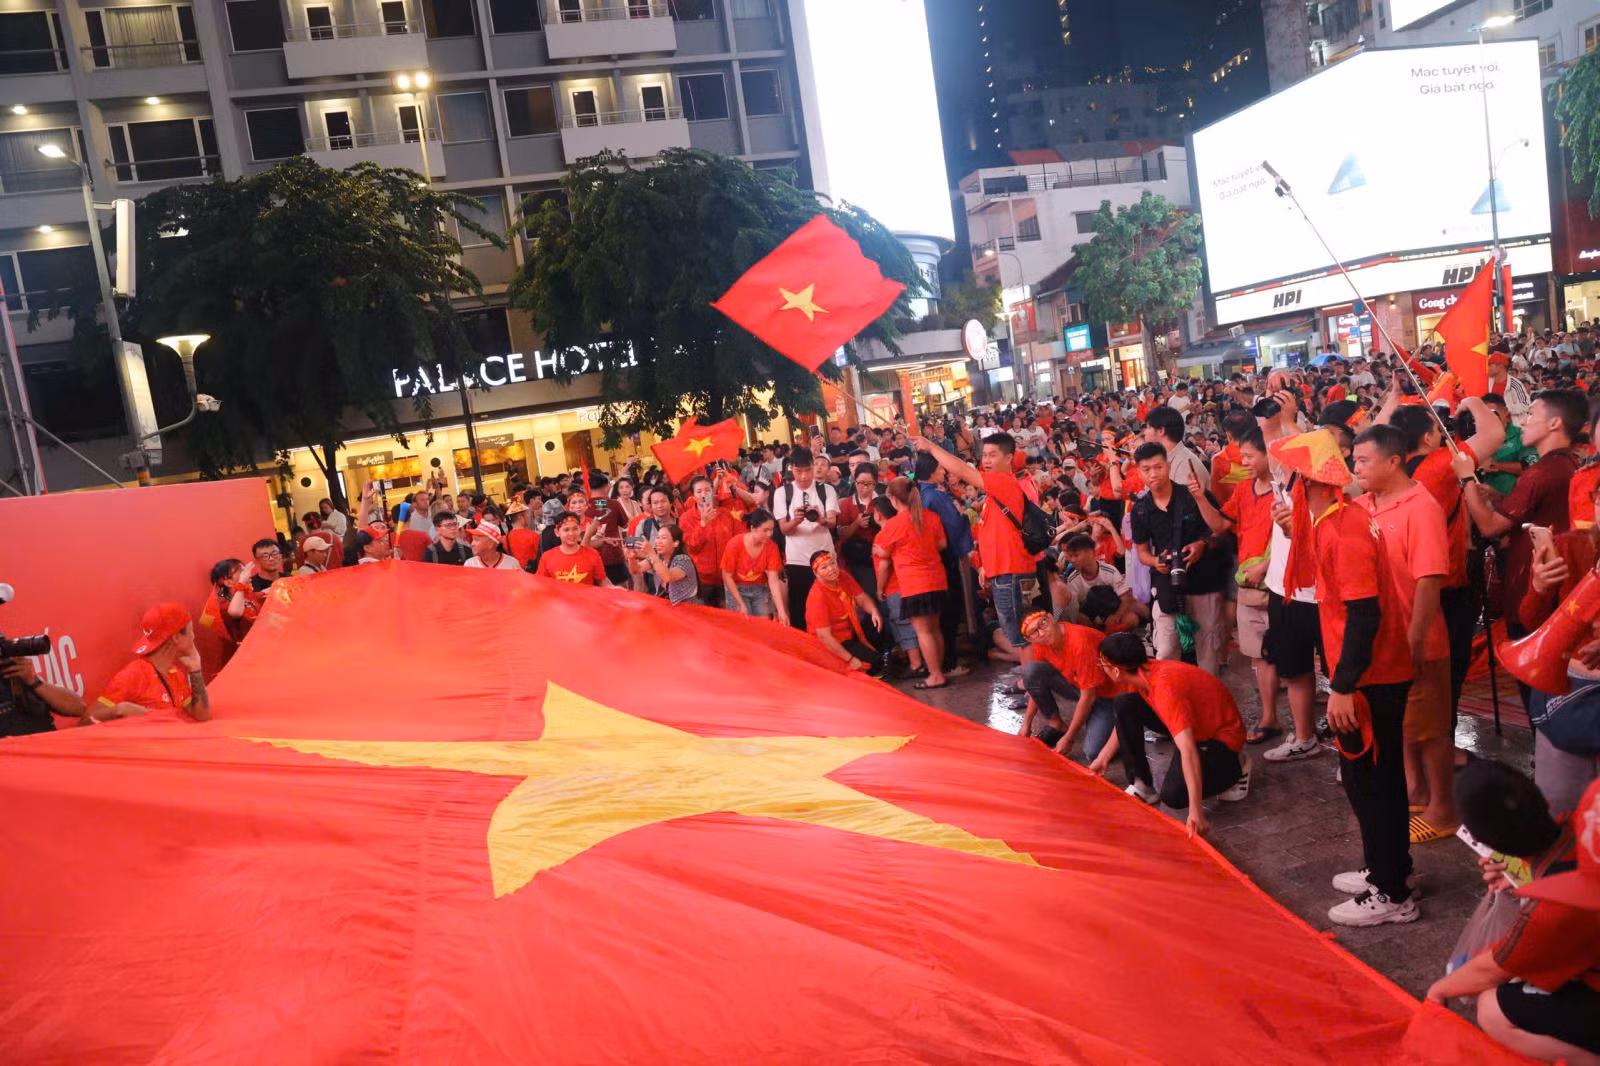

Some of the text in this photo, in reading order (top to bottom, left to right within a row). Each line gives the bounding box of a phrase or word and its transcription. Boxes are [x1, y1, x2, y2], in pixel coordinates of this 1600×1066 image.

[1411, 67, 1439, 78] Mac
[1419, 294, 1458, 310] Gong ch
[392, 353, 527, 398] PALCE
[534, 339, 638, 379] HOTL
